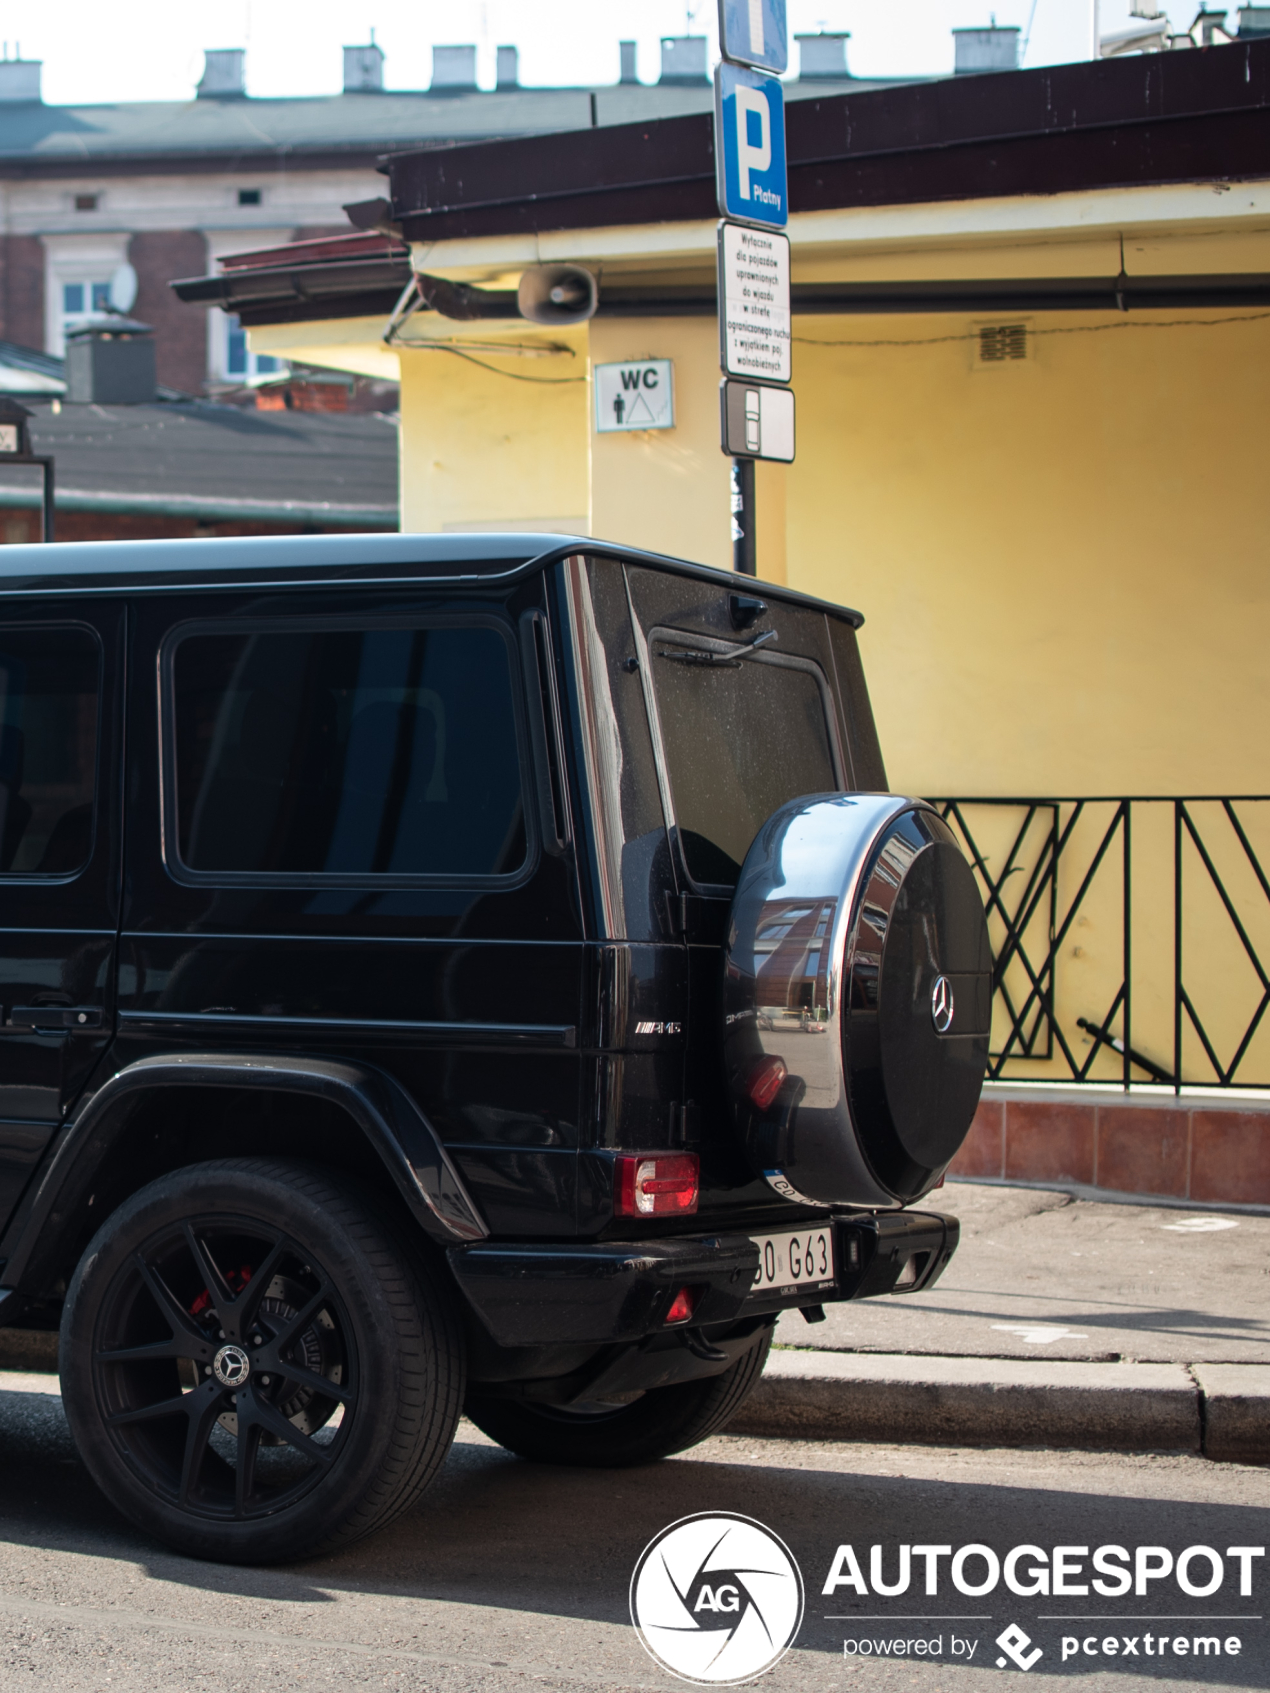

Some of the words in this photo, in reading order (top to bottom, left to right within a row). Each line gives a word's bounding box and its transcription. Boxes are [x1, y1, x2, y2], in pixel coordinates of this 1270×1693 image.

[735, 83, 772, 201] P
[753, 184, 782, 212] Płatny
[736, 249, 747, 262] dla
[749, 253, 779, 268] pojazdów
[736, 270, 780, 287] uprawnionych
[743, 286, 752, 297] do
[753, 287, 775, 303] wjazdu
[728, 320, 773, 340] ograniczonego
[620, 367, 659, 391] WC
[788, 1233, 828, 1280] G63
